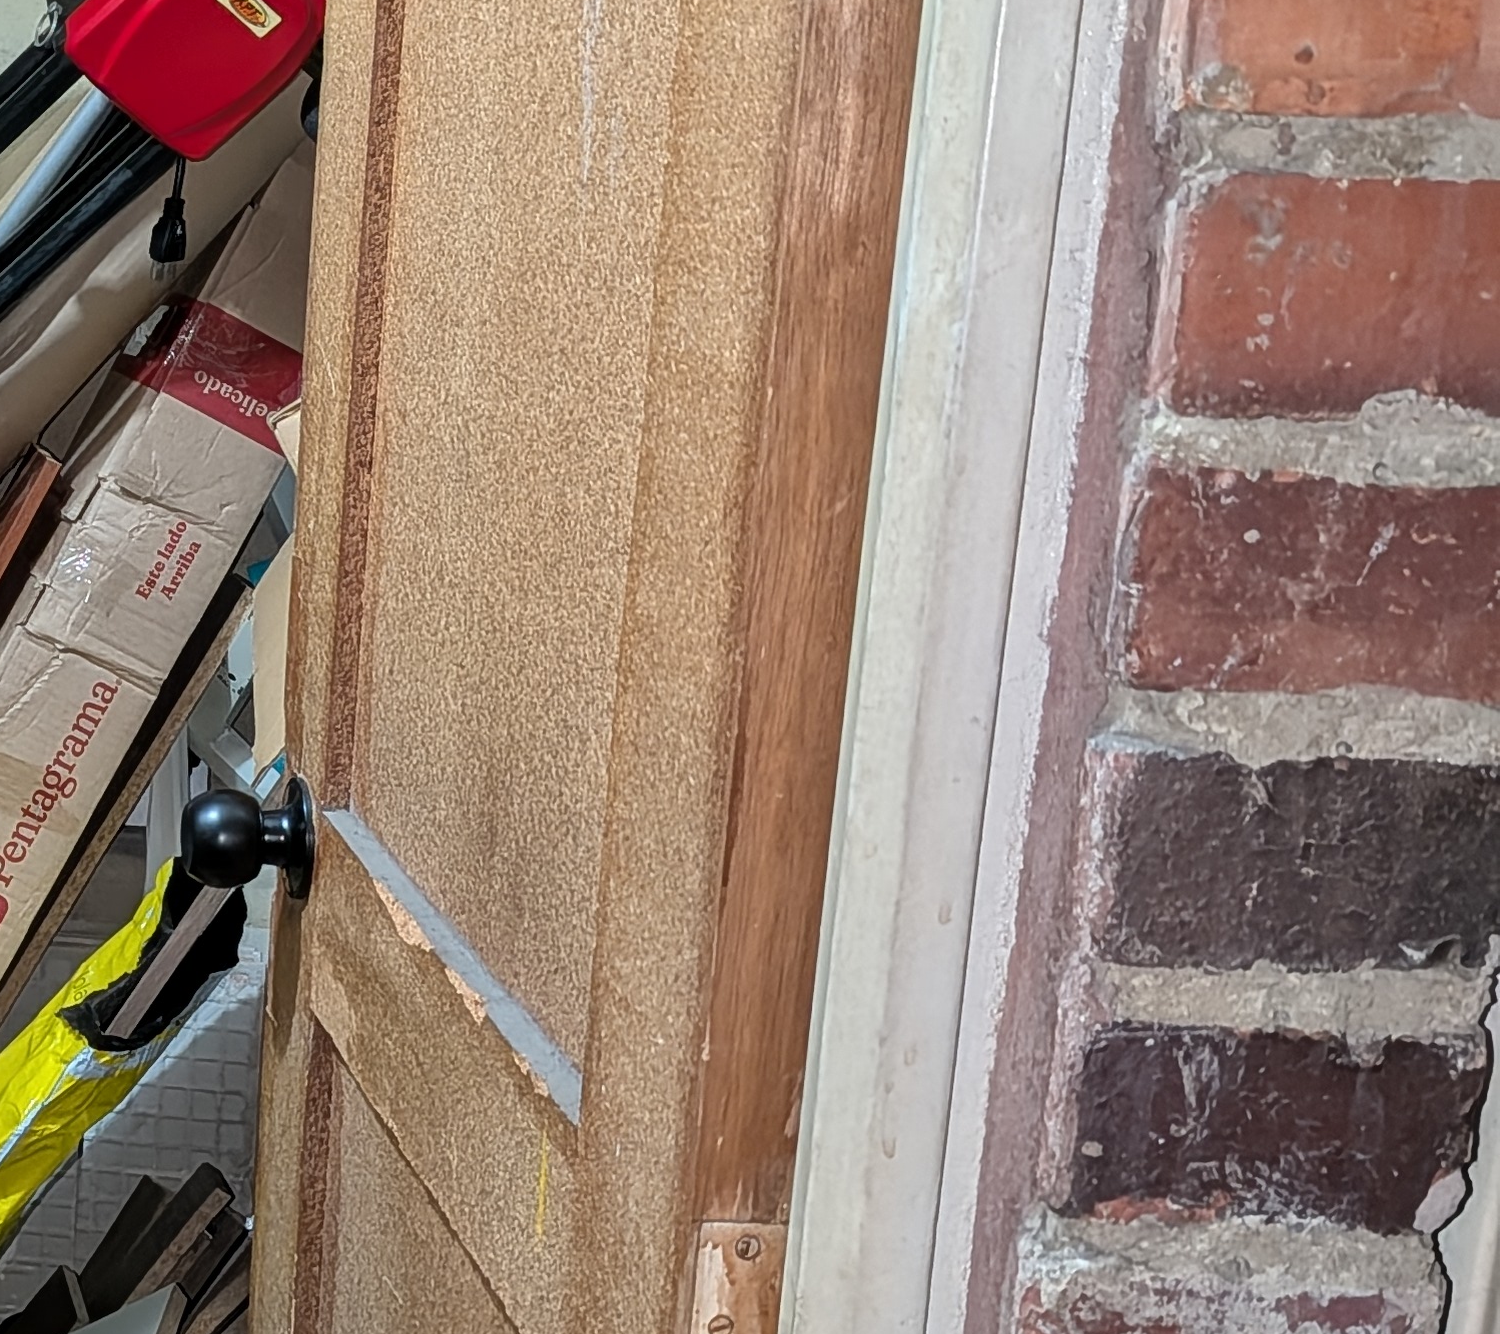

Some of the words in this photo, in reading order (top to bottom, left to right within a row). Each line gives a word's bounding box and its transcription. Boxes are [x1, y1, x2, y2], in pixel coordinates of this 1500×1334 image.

[135, 561, 166, 600] Este
[157, 521, 187, 560] lado
[160, 541, 202, 601] Arriba
